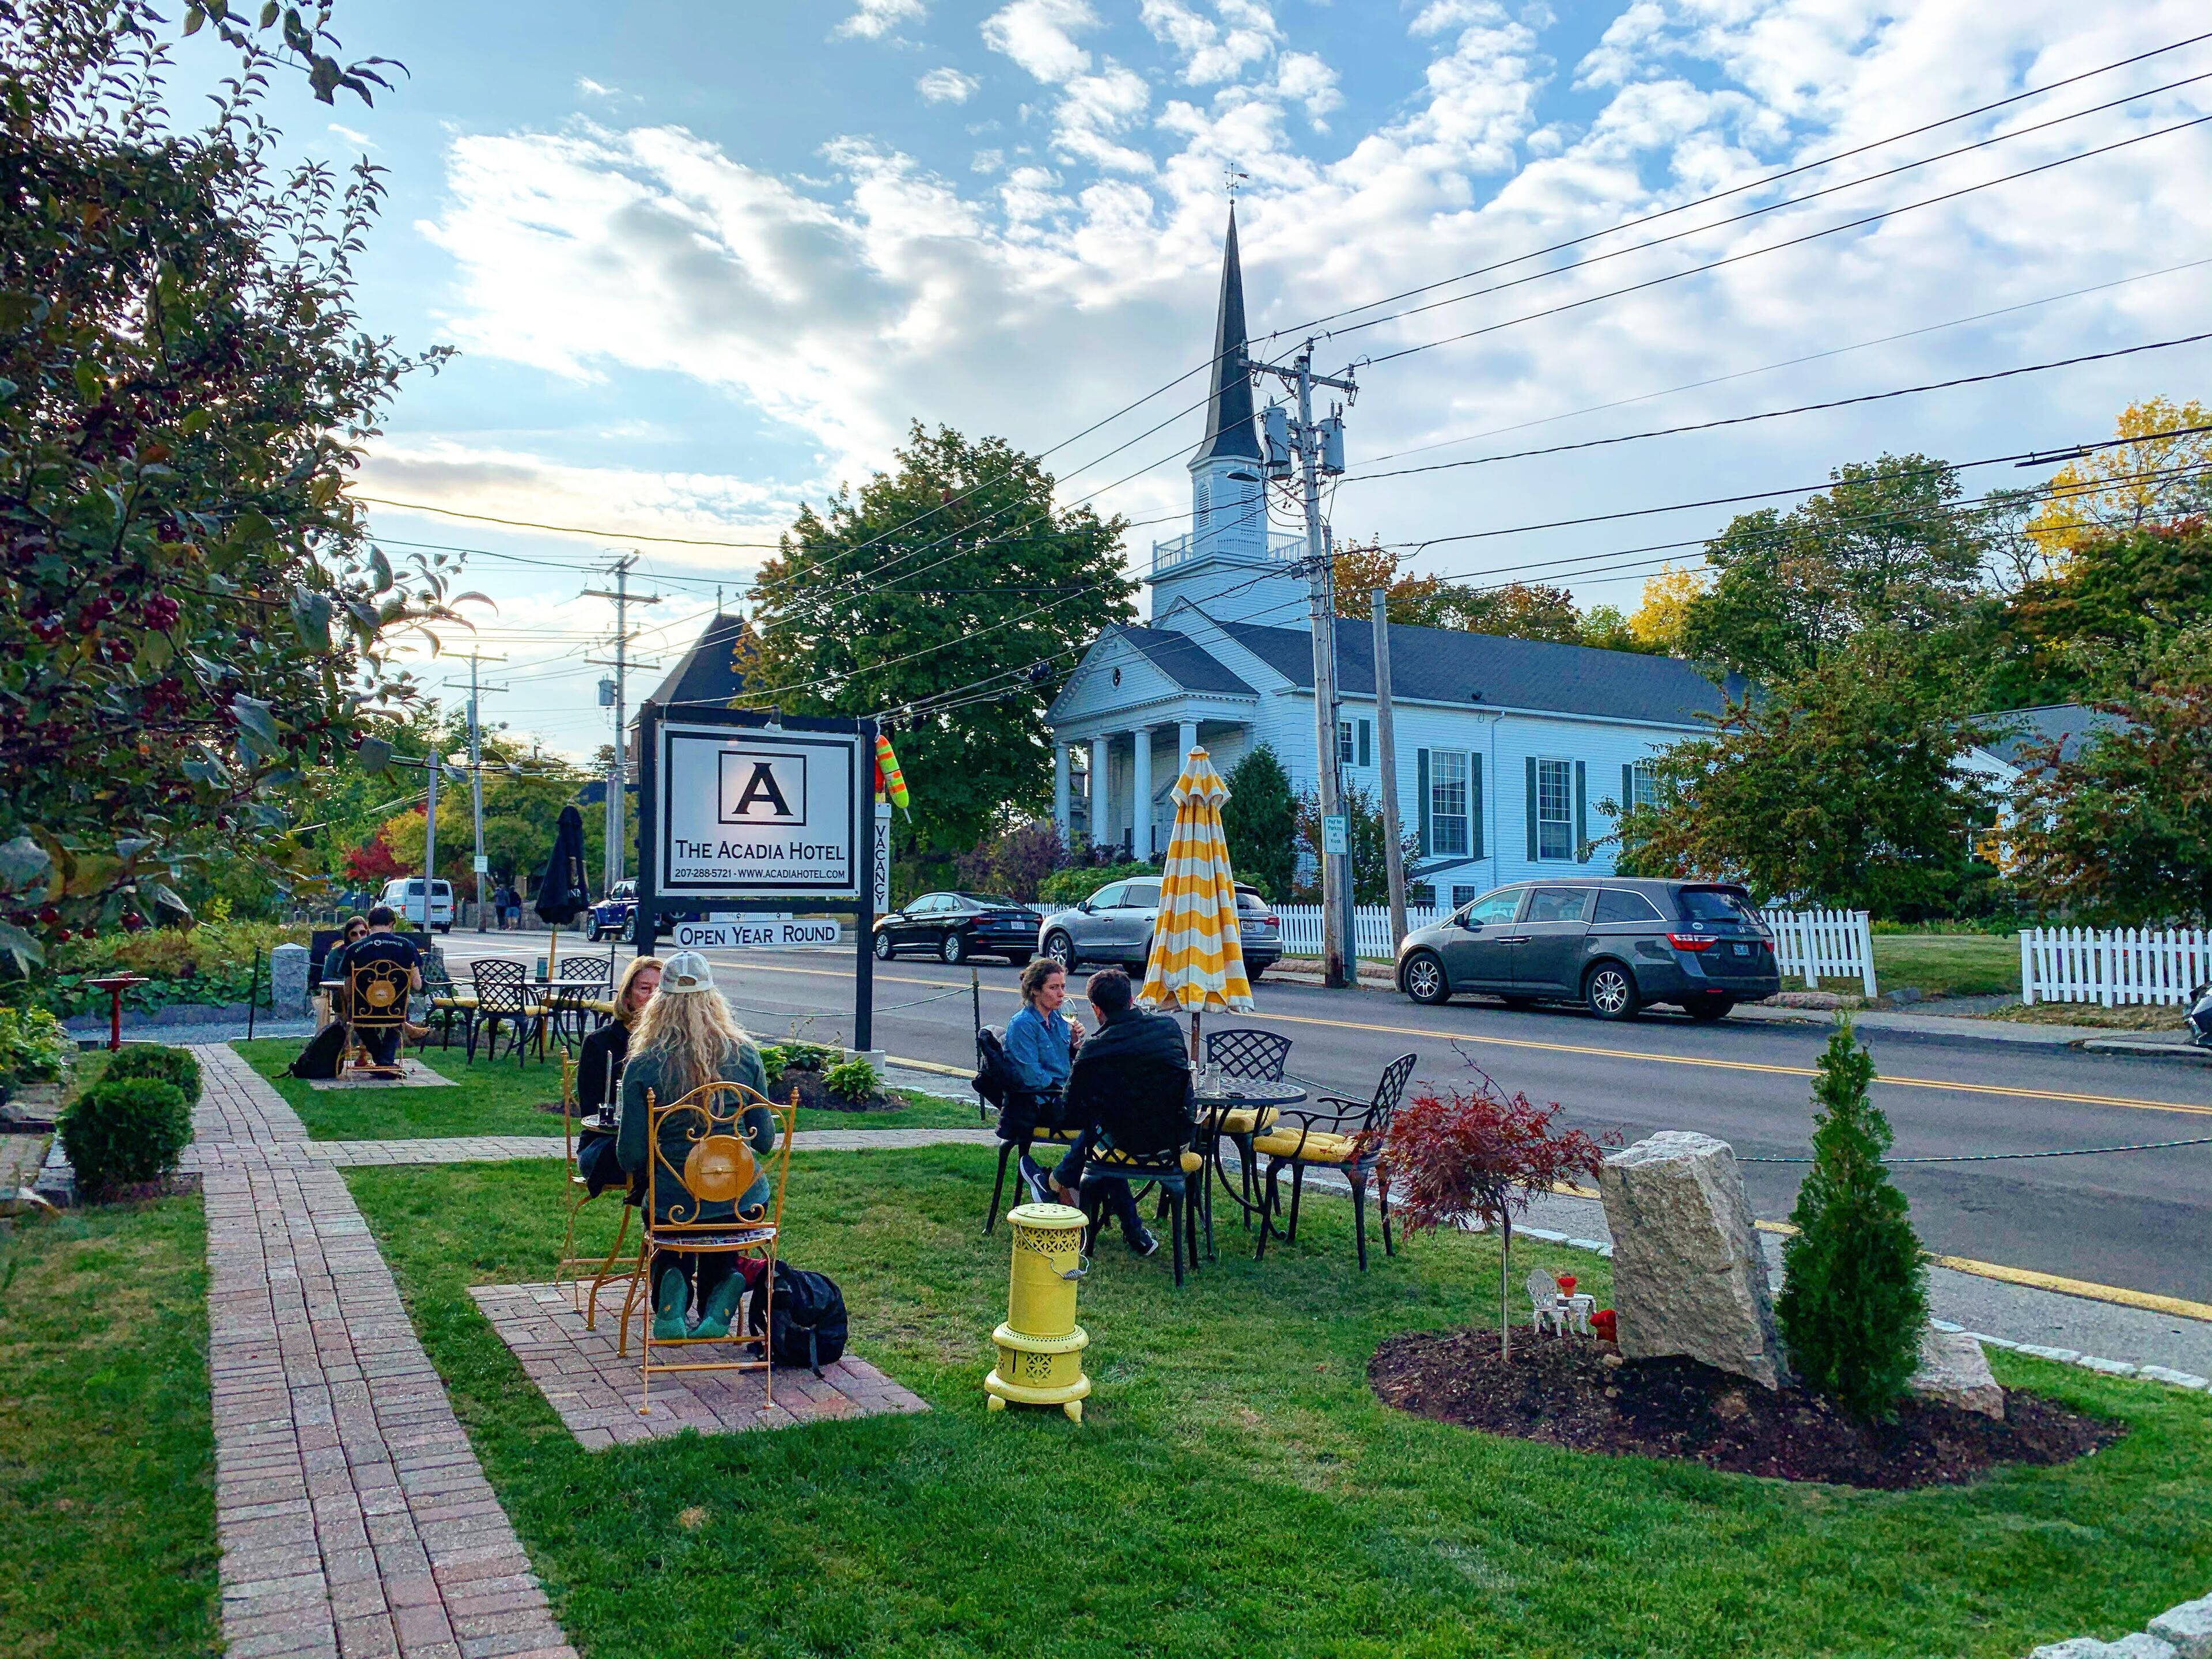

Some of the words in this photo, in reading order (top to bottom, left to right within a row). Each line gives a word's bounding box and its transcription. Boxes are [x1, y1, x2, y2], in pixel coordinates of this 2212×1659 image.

[732, 762, 794, 816] A
[675, 839, 712, 858] THE
[717, 840, 784, 859] ACADIA
[790, 842, 845, 860] HOTEL
[675, 869, 732, 877] 207-288-5721
[738, 869, 844, 878] WWW.ACADIAHOTEL.COM
[874, 825, 886, 906] VACANCY
[680, 927, 725, 945] OPEN
[732, 926, 773, 944] YEAR
[783, 925, 835, 942] ROUND
